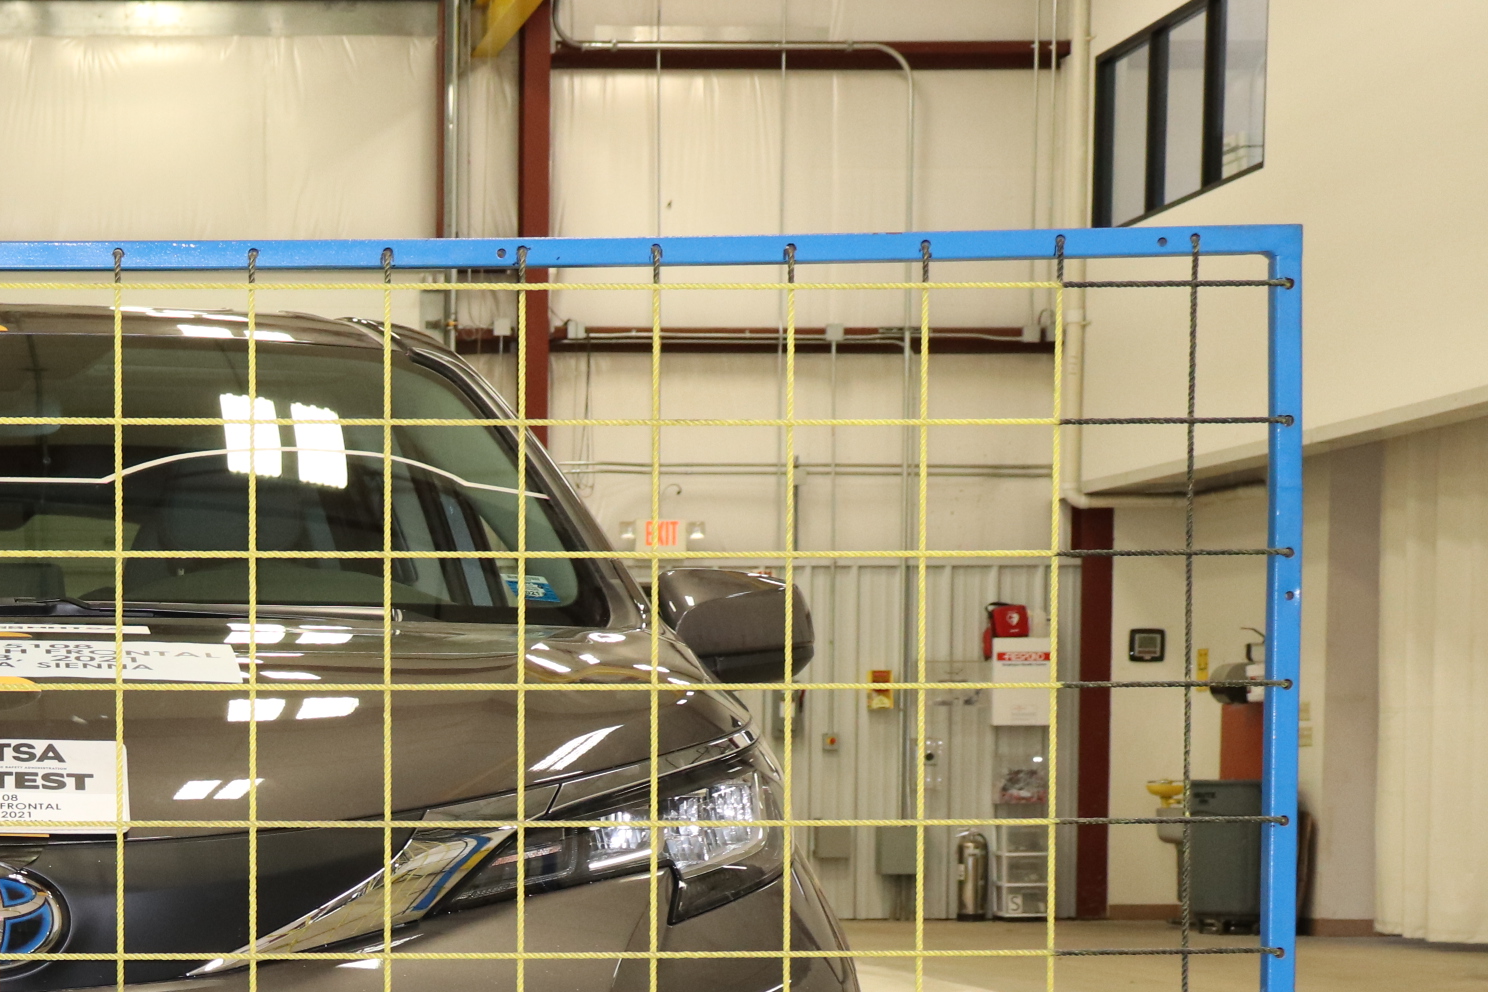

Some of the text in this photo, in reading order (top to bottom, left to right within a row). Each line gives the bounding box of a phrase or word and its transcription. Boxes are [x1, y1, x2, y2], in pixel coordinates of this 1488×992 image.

[645, 520, 680, 546] EXIT
[44, 648, 222, 659] FRONTAL
[50, 654, 139, 664] 2021
[36, 661, 154, 671] SIENNA
[0, 802, 63, 811] FRONTAL
[1, 810, 33, 819] 2021
[1010, 894, 1021, 912] S
